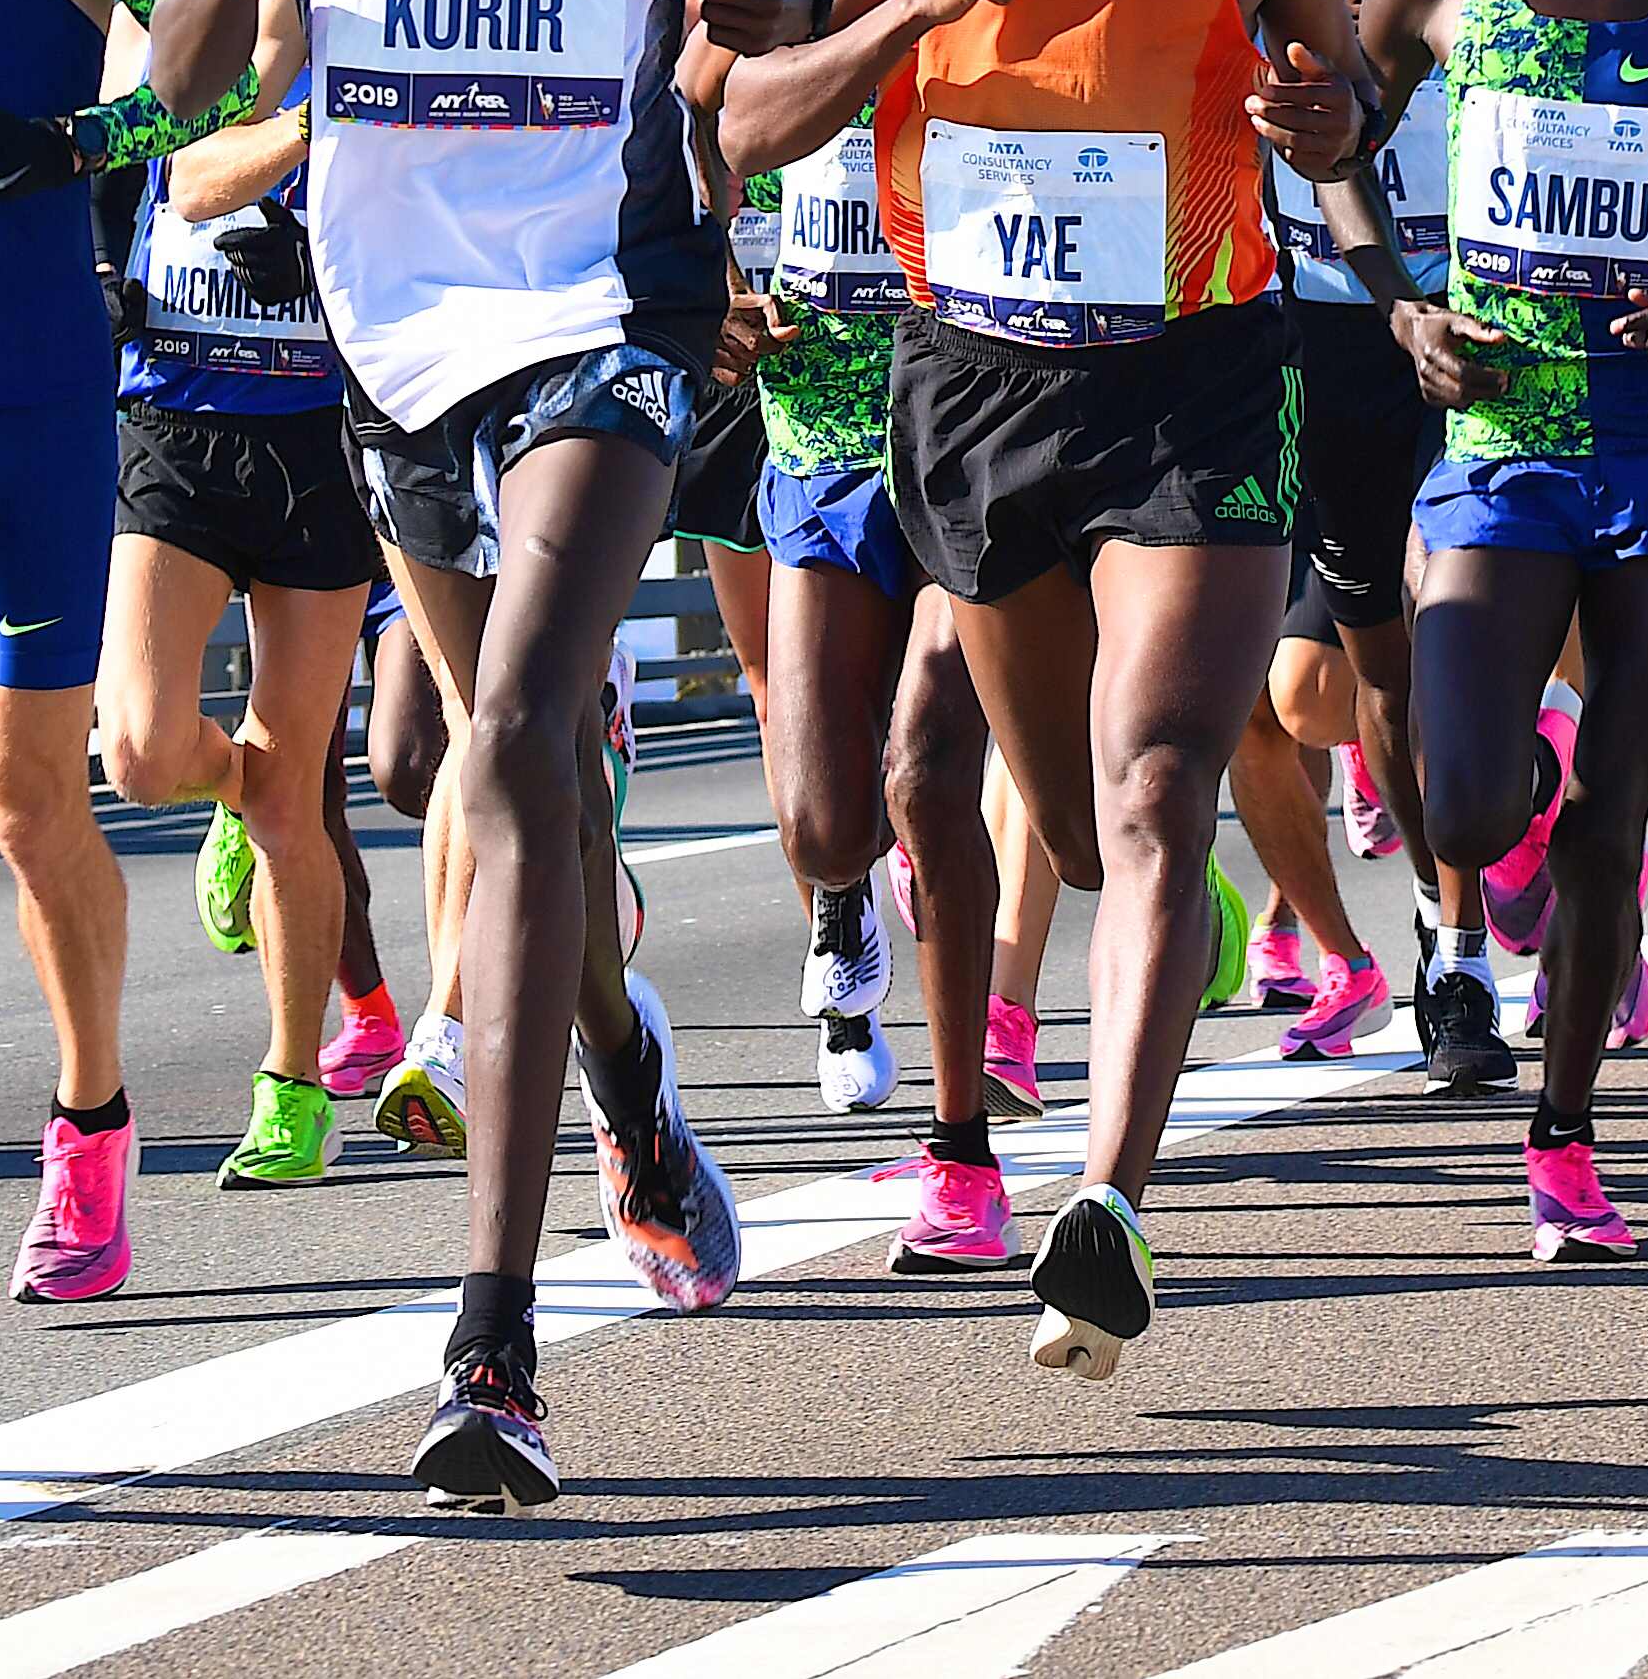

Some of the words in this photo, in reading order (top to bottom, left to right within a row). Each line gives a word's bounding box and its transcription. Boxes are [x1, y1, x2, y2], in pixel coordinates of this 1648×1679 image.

[342, 82, 399, 107] 2019
[1531, 108, 1566, 121] TATA
[845, 138, 872, 148] ATA
[988, 142, 1024, 155] TATA
[1526, 134, 1573, 150] ERVICES
[1607, 140, 1644, 153] TATA
[962, 152, 1052, 171] CONSULTANCY
[978, 169, 1035, 186] SERVICES
[1072, 172, 1114, 183] TATA
[792, 193, 894, 255] ABDIRA
[993, 213, 1082, 283] YAE
[1466, 249, 1511, 273] 2019
[154, 338, 190, 355] 2019
[1215, 503, 1278, 524] adidas
